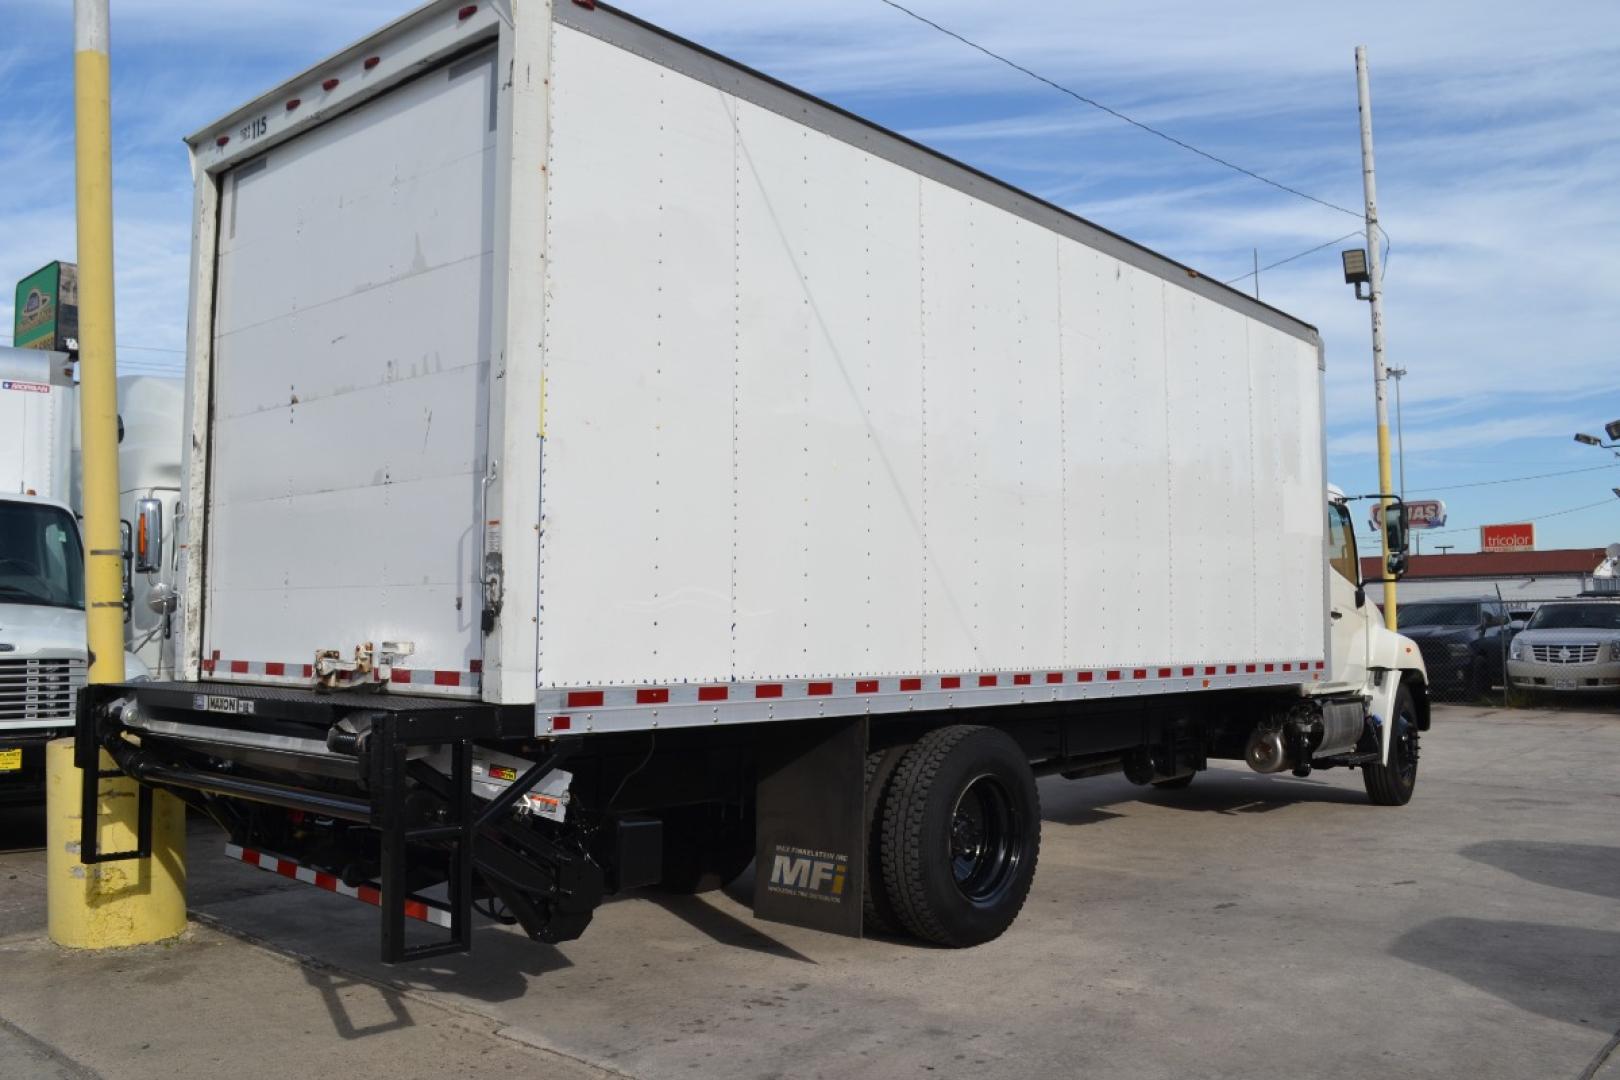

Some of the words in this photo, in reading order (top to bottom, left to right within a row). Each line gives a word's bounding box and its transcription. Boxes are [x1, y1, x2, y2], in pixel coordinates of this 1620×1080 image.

[253, 116, 267, 139] 115
[1488, 533, 1529, 547] tricolor
[770, 855, 848, 894] MFi
